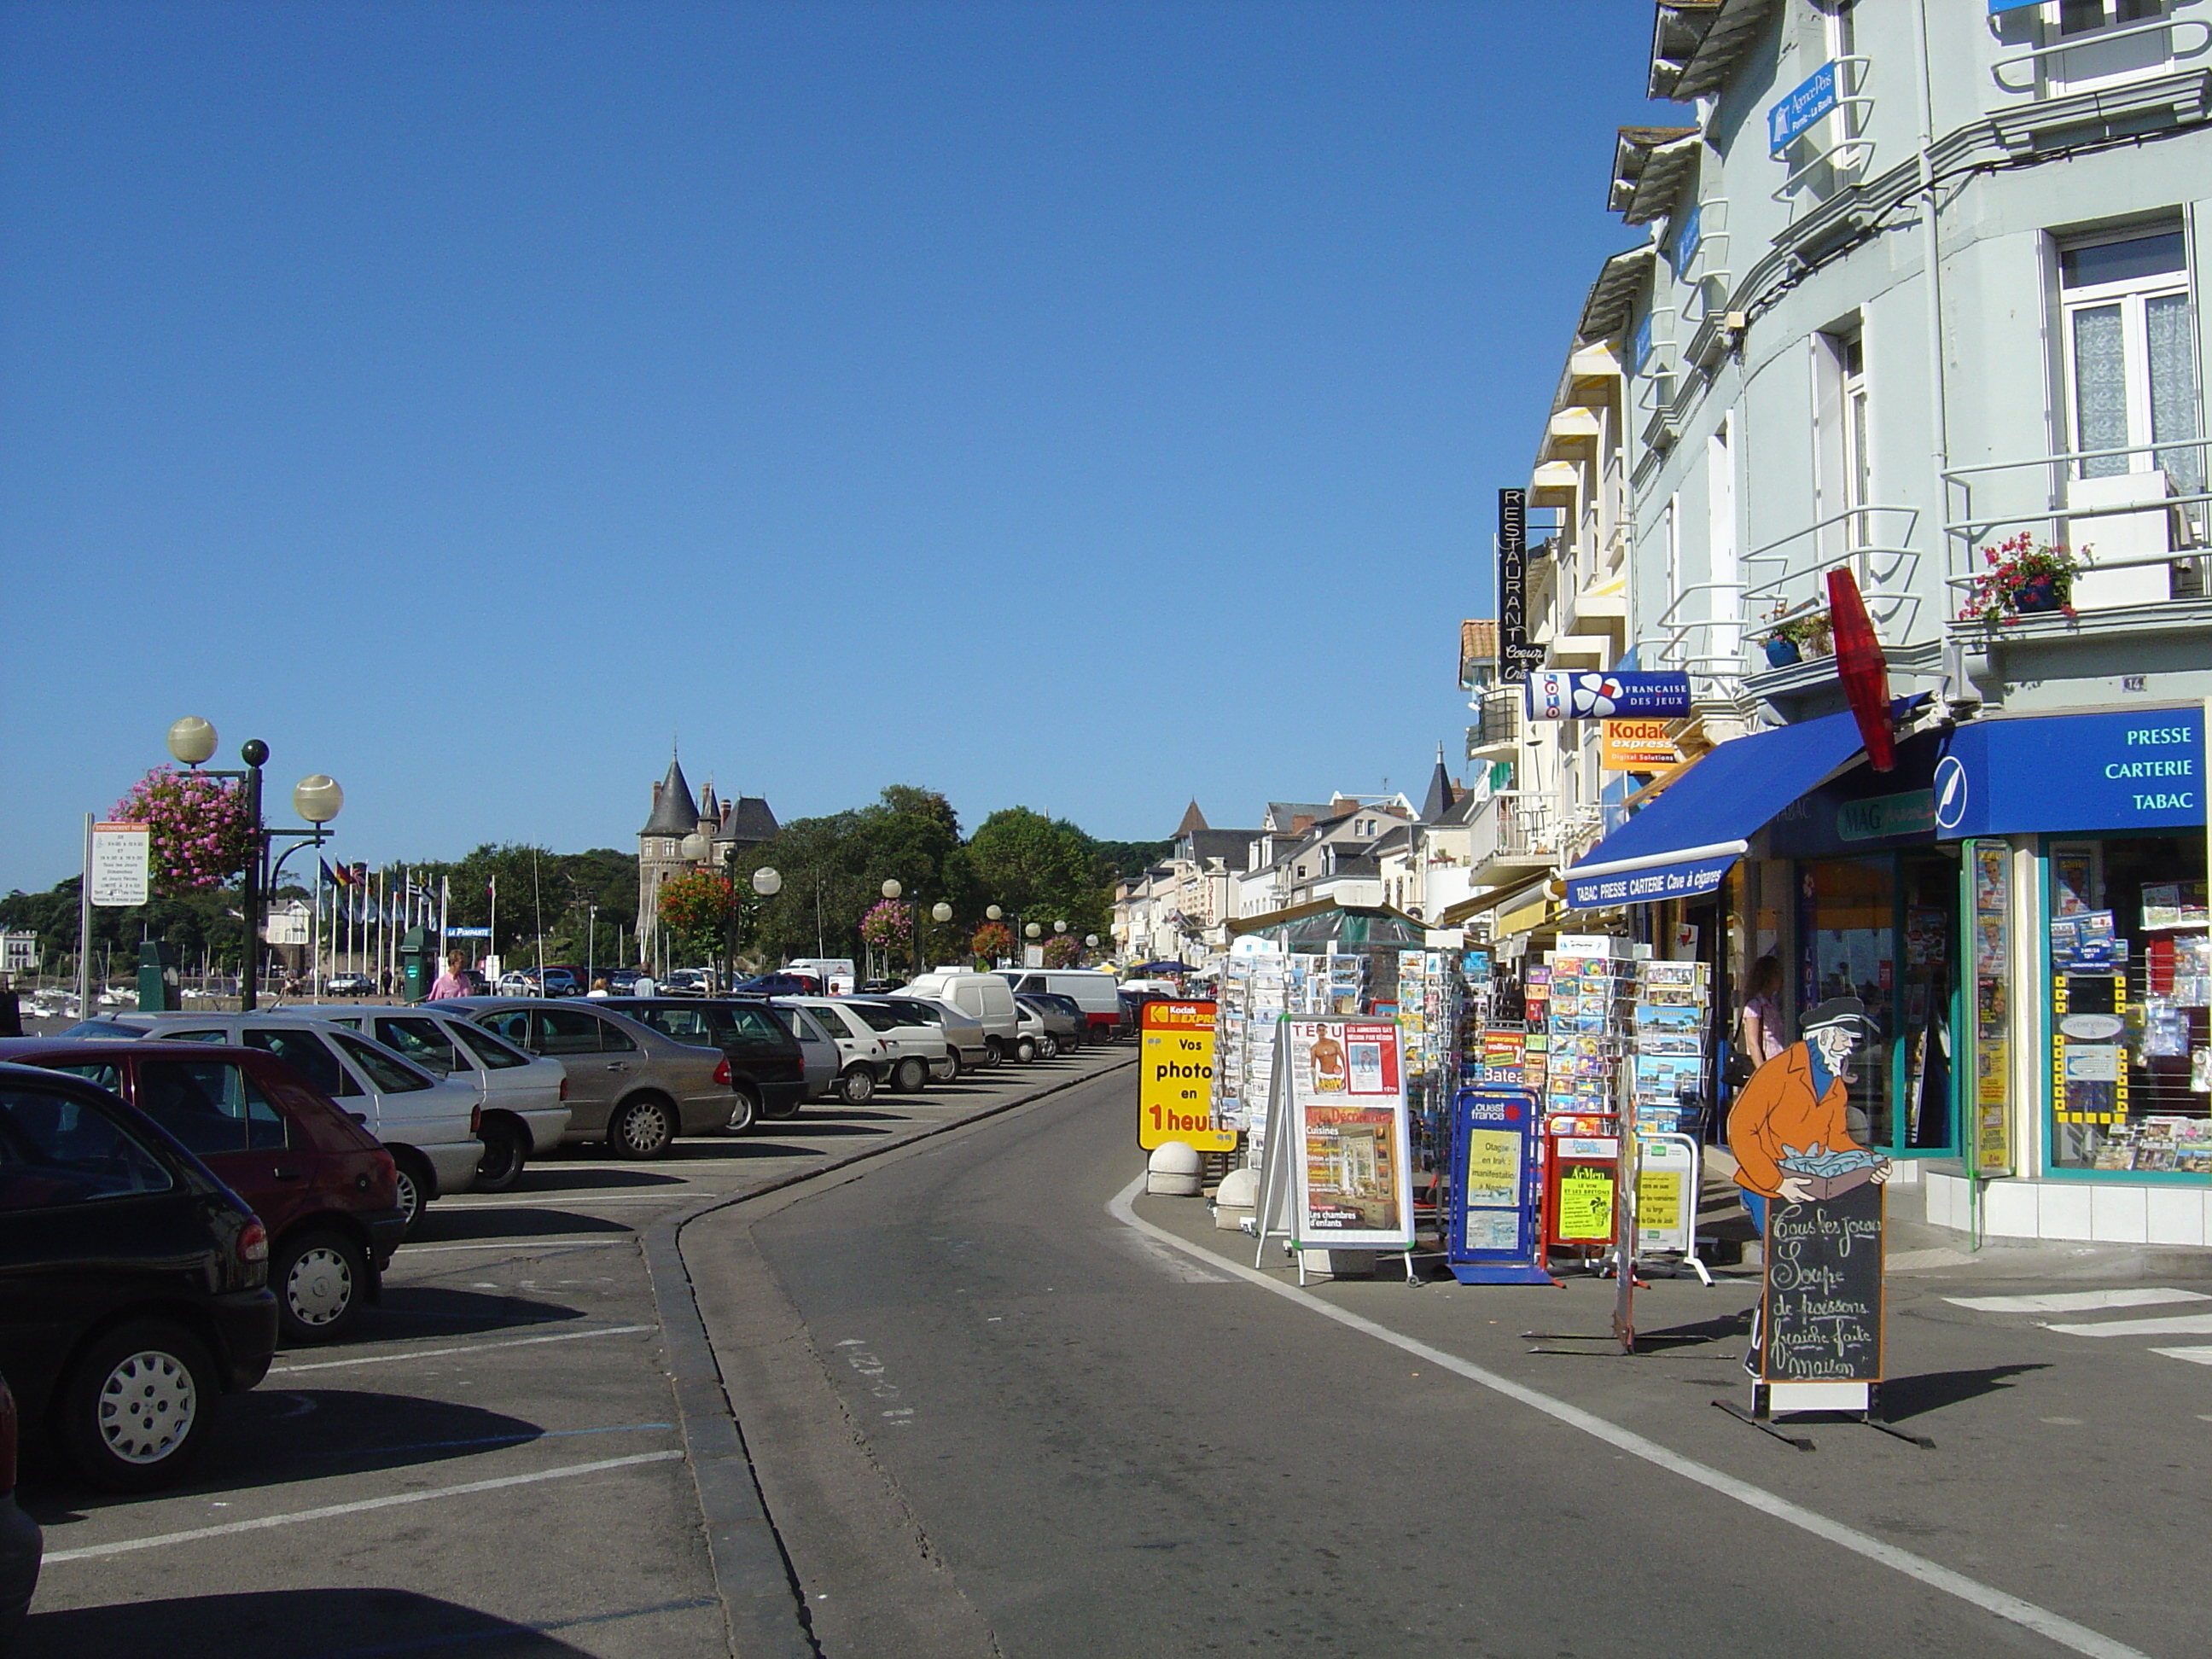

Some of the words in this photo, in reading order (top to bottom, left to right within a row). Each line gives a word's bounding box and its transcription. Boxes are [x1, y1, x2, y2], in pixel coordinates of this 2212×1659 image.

[1504, 490, 1522, 642] RESTAURANT
[1543, 673, 1561, 719] LOTO
[1625, 684, 1687, 696] FRANÇAISE
[1630, 696, 1650, 706] DES
[1655, 696, 1683, 707] JEUX
[1610, 722, 1669, 739] Kodak
[2128, 727, 2192, 746] PRESSE
[1611, 739, 1674, 749] express
[1611, 754, 1637, 762] Digital
[2105, 760, 2193, 779] CARTERIE
[2133, 792, 2193, 810] TABAC
[1576, 885, 1598, 902] TABAC
[1600, 881, 1627, 899] PRESSE
[1629, 875, 1664, 895] CARTERIE
[1667, 873, 1685, 890] Cave
[1686, 870, 1693, 888] à
[1694, 869, 1722, 889] cigares
[1169, 1006, 1197, 1015] Kodak
[1179, 1039, 1202, 1051] Vos
[1156, 1060, 1213, 1082] photo
[1181, 1089, 1197, 1099] en
[1476, 1102, 1505, 1112] ouest
[1149, 1103, 1161, 1131] 1
[1471, 1109, 1505, 1121] france
[1306, 1126, 1339, 1136] Cuisines
[1572, 1168, 1605, 1179] ArMen
[1309, 1210, 1321, 1219] Les
[1322, 1210, 1357, 1220] chambres
[1309, 1219, 1342, 1227] d'enfants
[1770, 1204, 1816, 1243] Tous
[1817, 1208, 1841, 1235] les
[1770, 1241, 1845, 1295] Soupe
[1773, 1294, 1793, 1316] de
